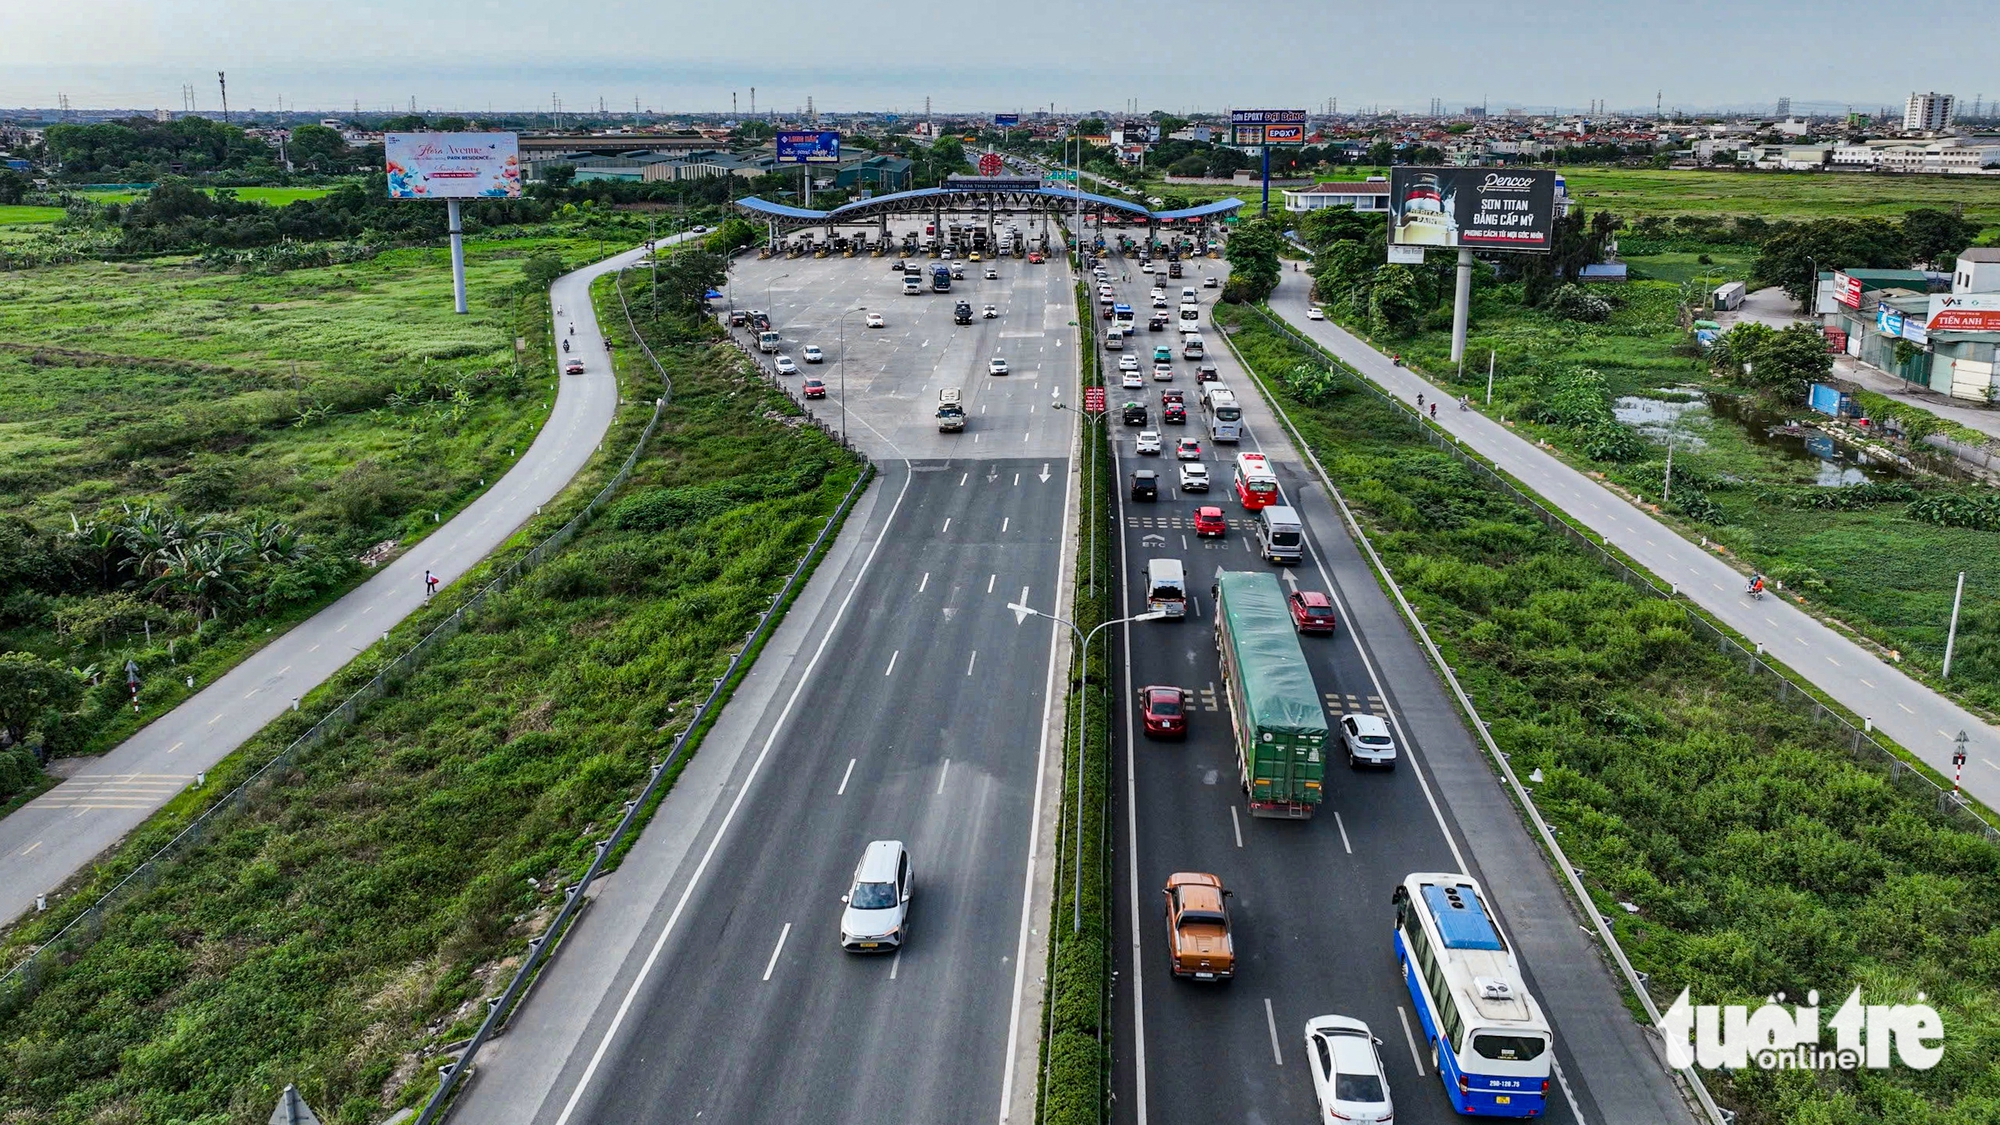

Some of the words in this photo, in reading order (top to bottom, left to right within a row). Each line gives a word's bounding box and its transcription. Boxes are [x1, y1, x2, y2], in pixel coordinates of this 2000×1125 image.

[1244, 112, 1263, 121] EPOXY
[1269, 129, 1296, 137] EPOXY
[446, 144, 482, 155] Avenue
[1477, 173, 1536, 194] Pencco
[1481, 199, 1501, 210] SƠN
[1503, 199, 1529, 211] TITAN
[1473, 210, 1498, 225] ĐẲNG
[1500, 211, 1519, 226] CẤP
[1520, 213, 1535, 227] MỸ
[1464, 229, 1482, 237] PHONG
[1483, 229, 1498, 237] CÁCH
[1938, 315, 1960, 325] TIẾN
[1961, 317, 1983, 325] ANH
